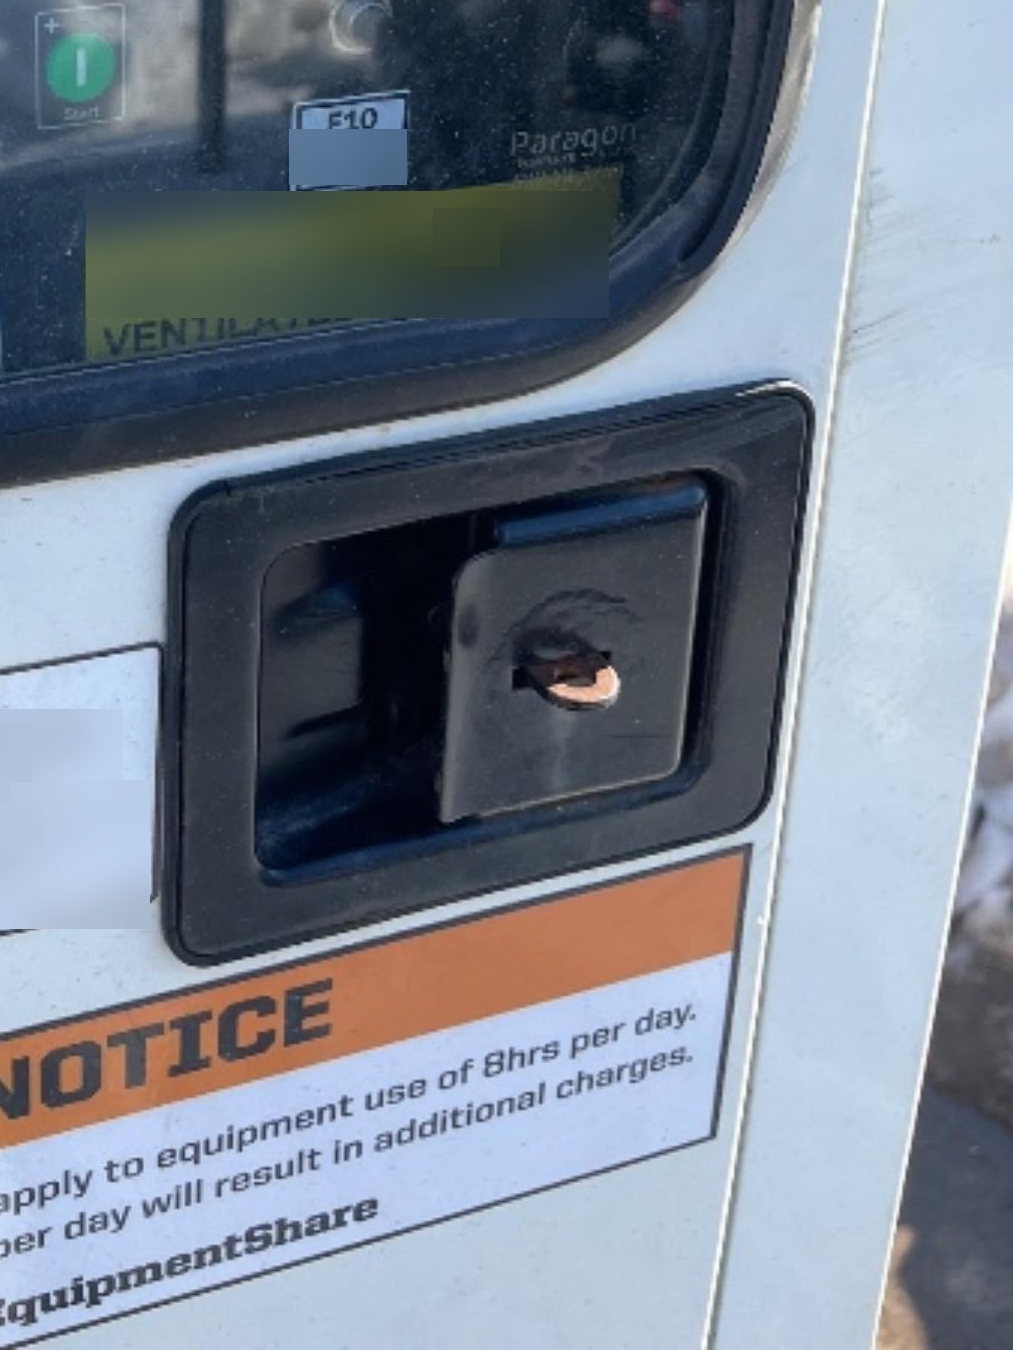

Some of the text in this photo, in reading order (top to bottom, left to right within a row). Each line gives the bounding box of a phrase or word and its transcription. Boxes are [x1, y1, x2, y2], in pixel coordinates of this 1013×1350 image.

[510, 123, 636, 157] Paragon
[63, 1202, 131, 1240] day
[141, 1179, 205, 1221] will
[213, 1148, 321, 1200] result
[332, 1137, 365, 1164] in
[373, 1082, 545, 1153] additional
[555, 1048, 693, 1100] charges.
[105, 1156, 145, 1184] to
[156, 1092, 355, 1167] equipment
[363, 1075, 428, 1113] use
[437, 1058, 476, 1092] of
[482, 1038, 561, 1080] 8hrs
[567, 1023, 626, 1063] per
[634, 1000, 697, 1039] day.
